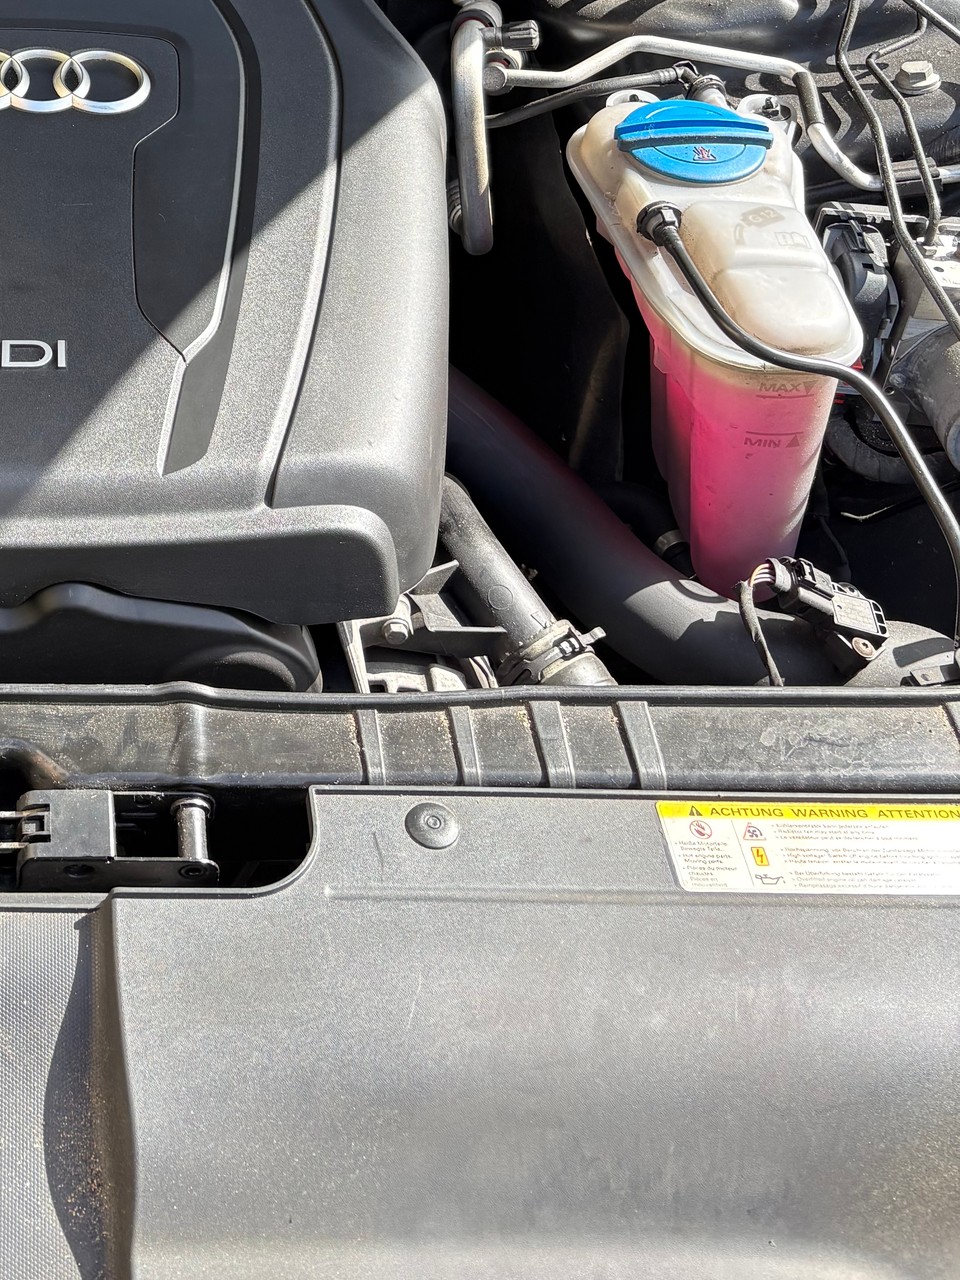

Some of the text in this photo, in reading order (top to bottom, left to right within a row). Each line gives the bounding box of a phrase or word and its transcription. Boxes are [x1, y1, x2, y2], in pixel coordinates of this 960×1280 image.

[759, 382, 802, 392] MAX
[743, 437, 780, 448] MIN
[710, 807, 960, 819] ACHTUNG WARNING ATTENTION
